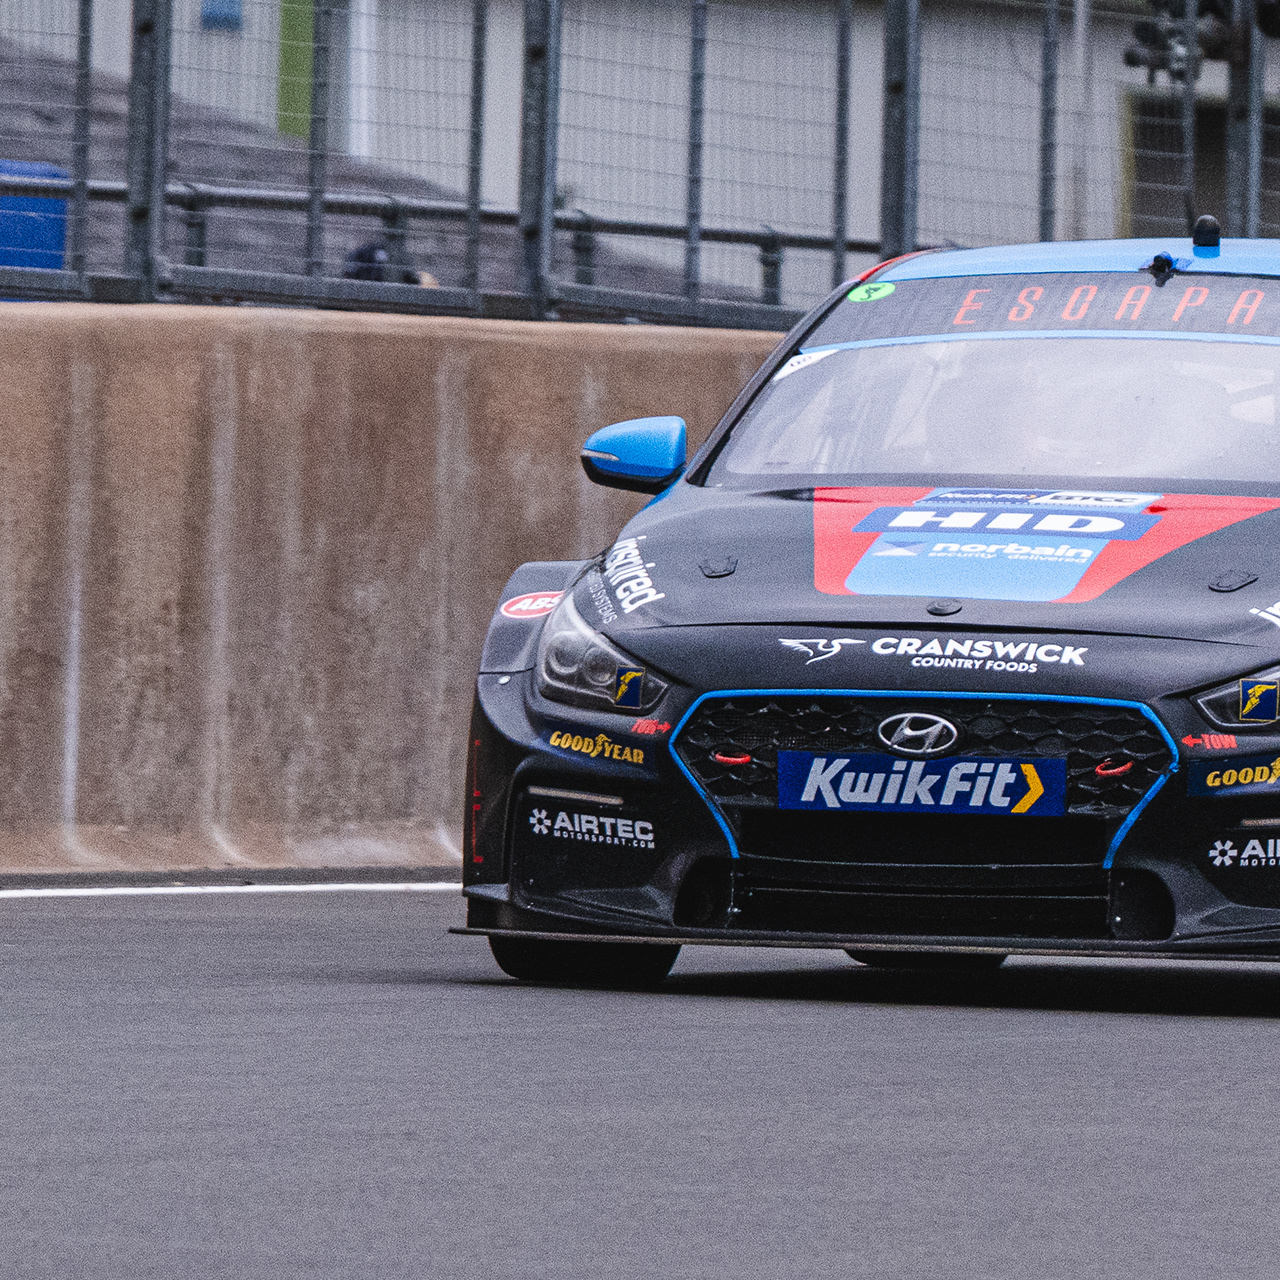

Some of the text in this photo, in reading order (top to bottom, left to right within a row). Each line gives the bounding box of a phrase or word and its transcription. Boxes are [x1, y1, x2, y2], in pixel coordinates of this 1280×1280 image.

[887, 510, 1126, 533] HID
[928, 551, 1089, 564] security delivered
[932, 542, 1095, 559] norbain
[604, 535, 665, 614] inspired
[871, 636, 1089, 666] CRANSWICK
[911, 656, 1038, 674] COUNTRY FOODS
[550, 730, 644, 764] GOODYEAR
[1201, 733, 1238, 750] TOW
[554, 811, 655, 840] AIRTEC
[553, 830, 656, 850] MOTORSPORT.COM
